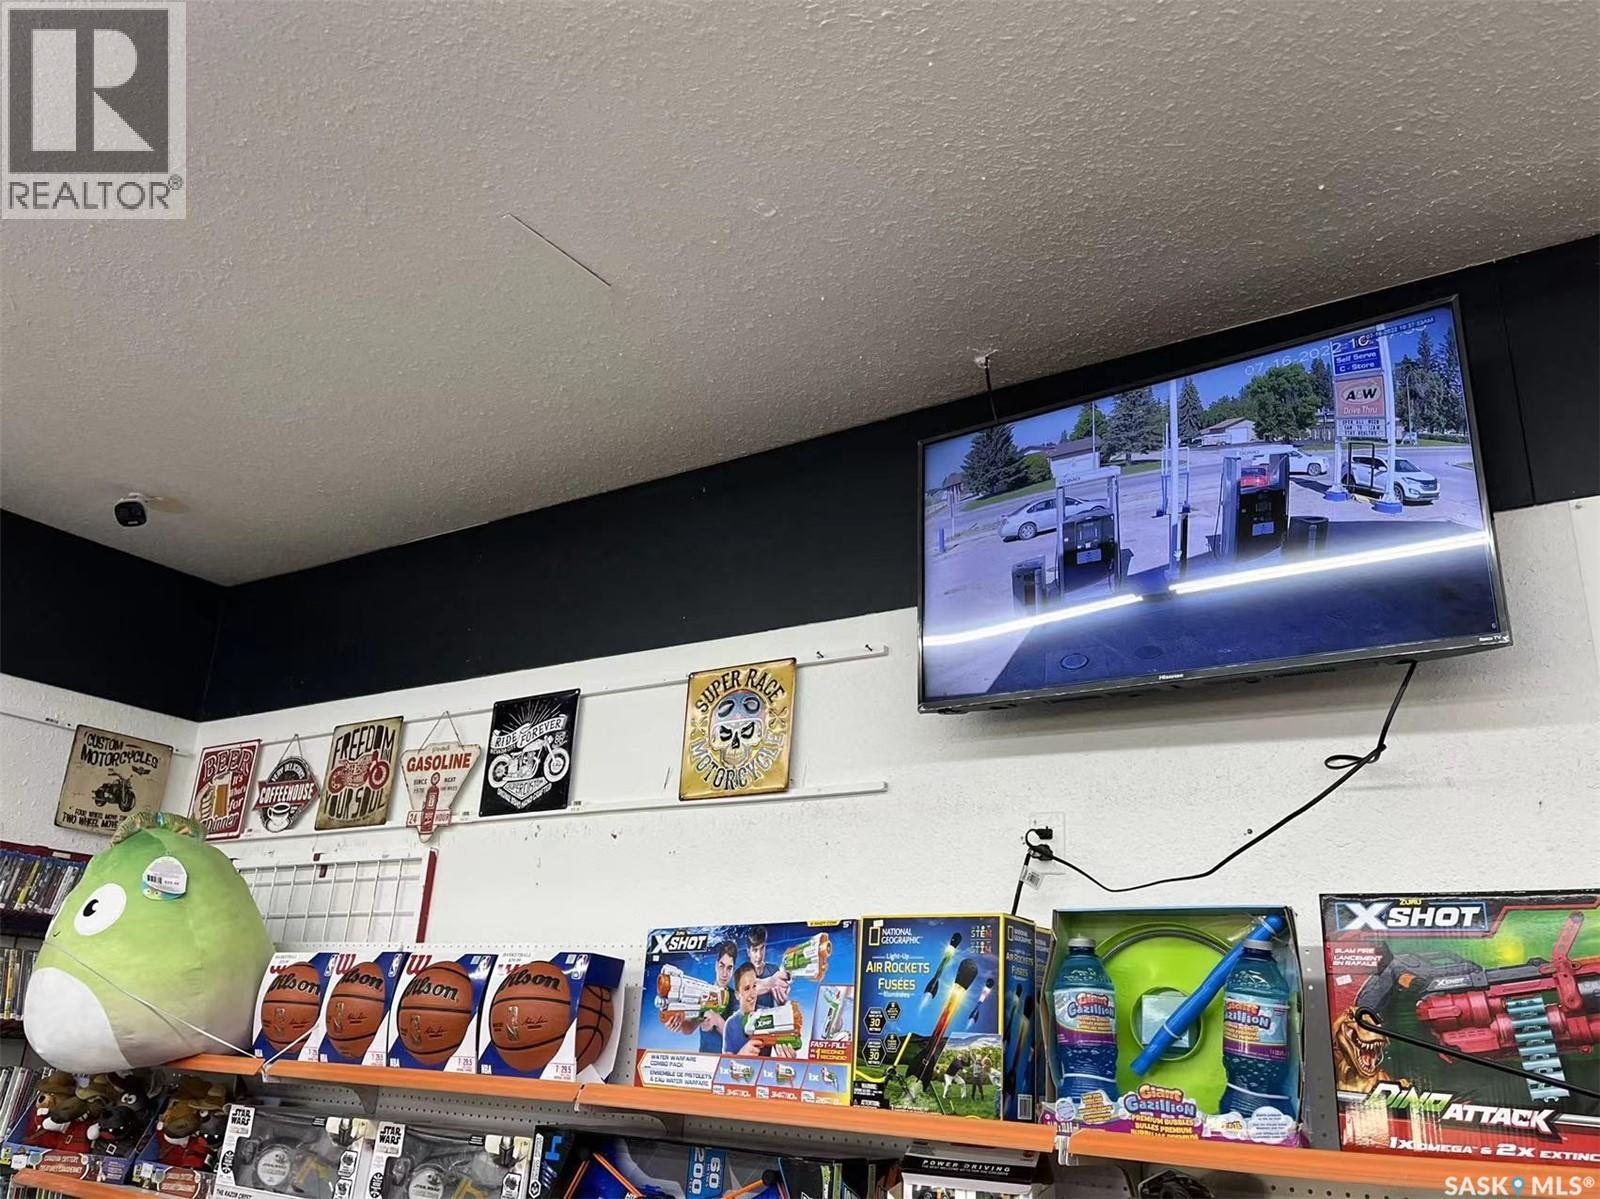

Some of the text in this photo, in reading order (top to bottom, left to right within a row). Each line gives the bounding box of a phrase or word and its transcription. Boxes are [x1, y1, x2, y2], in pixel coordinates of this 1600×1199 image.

[1336, 351, 1377, 363] Self Serve
[1352, 363, 1375, 371] Store
[1343, 406, 1360, 414] Drive
[695, 669, 785, 713] SUPER RACE
[86, 733, 124, 750] CUSTOM
[495, 731, 517, 748] RIDE
[332, 725, 396, 770] FREEDOM
[81, 744, 159, 768] MOTORCYCLES
[690, 731, 785, 790] MOTORCYCLE
[203, 749, 253, 781] BEER
[407, 753, 472, 772] GASOLINE
[259, 783, 314, 804] COFFEEHOUSE
[229, 797, 244, 813] for
[324, 787, 385, 819] YOUR SOUL
[62, 811, 77, 825] TWO
[409, 813, 418, 824] 24
[882, 928, 912, 936] NATIONAL
[971, 930, 992, 938] STEM
[881, 936, 921, 944] GEOGRAPHIC
[866, 961, 930, 974] AIR ROCKETS
[870, 1018, 881, 1027] 30
[869, 1052, 880, 1060] 30
[1138, 1084, 1183, 1102] Giant
[232, 1109, 251, 1118] STAR
[1441, 1103, 1556, 1133] ATTACK
[231, 1116, 250, 1126] WARS
[1132, 1115, 1193, 1126] PREMIUM BUBBLES
[1135, 1122, 1159, 1131] BULLES
[380, 1126, 401, 1136] STAR
[379, 1135, 400, 1145] WARS
[922, 1160, 1011, 1172] POWER DRIVING
